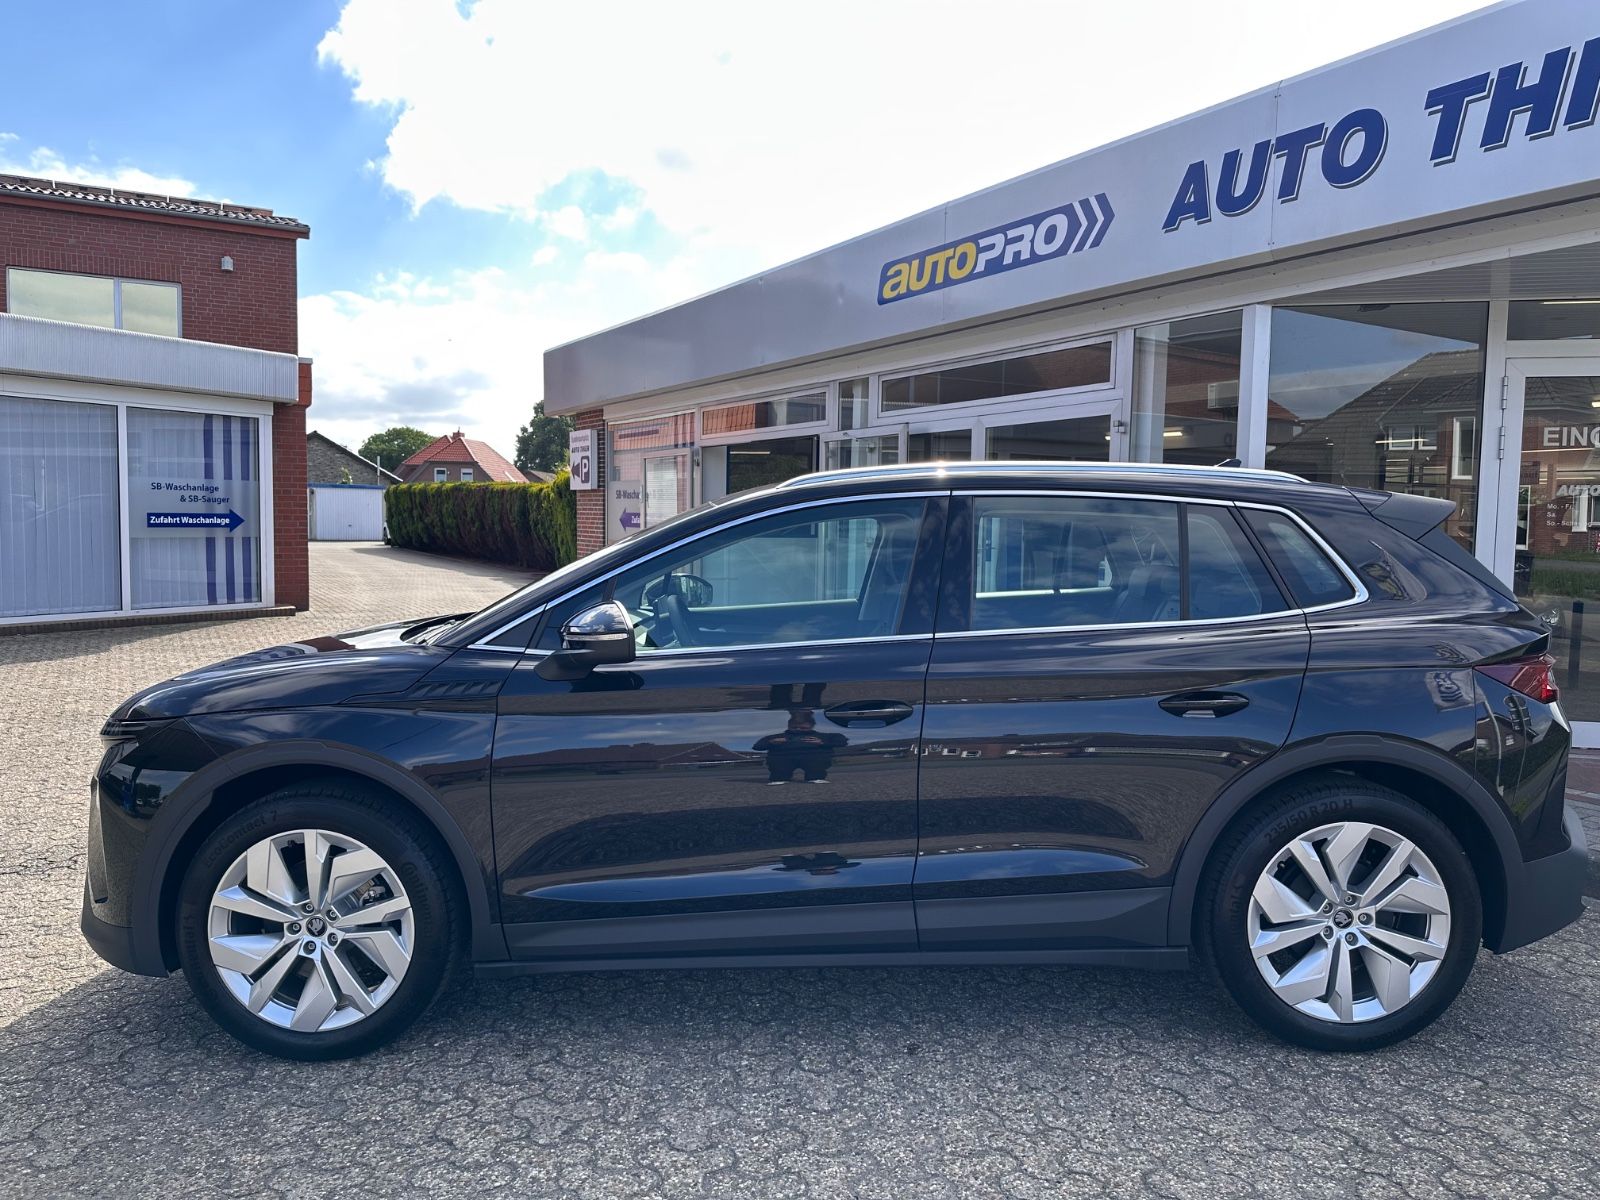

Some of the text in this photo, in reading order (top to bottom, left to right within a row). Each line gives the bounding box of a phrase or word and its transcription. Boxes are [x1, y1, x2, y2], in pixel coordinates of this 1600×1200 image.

[1162, 108, 1388, 233] AUTO
[151, 482, 219, 494] SB-Waschanlage
[179, 494, 230, 505] & SB-Sauger
[150, 516, 230, 526] Zufahrt Waschanlage
